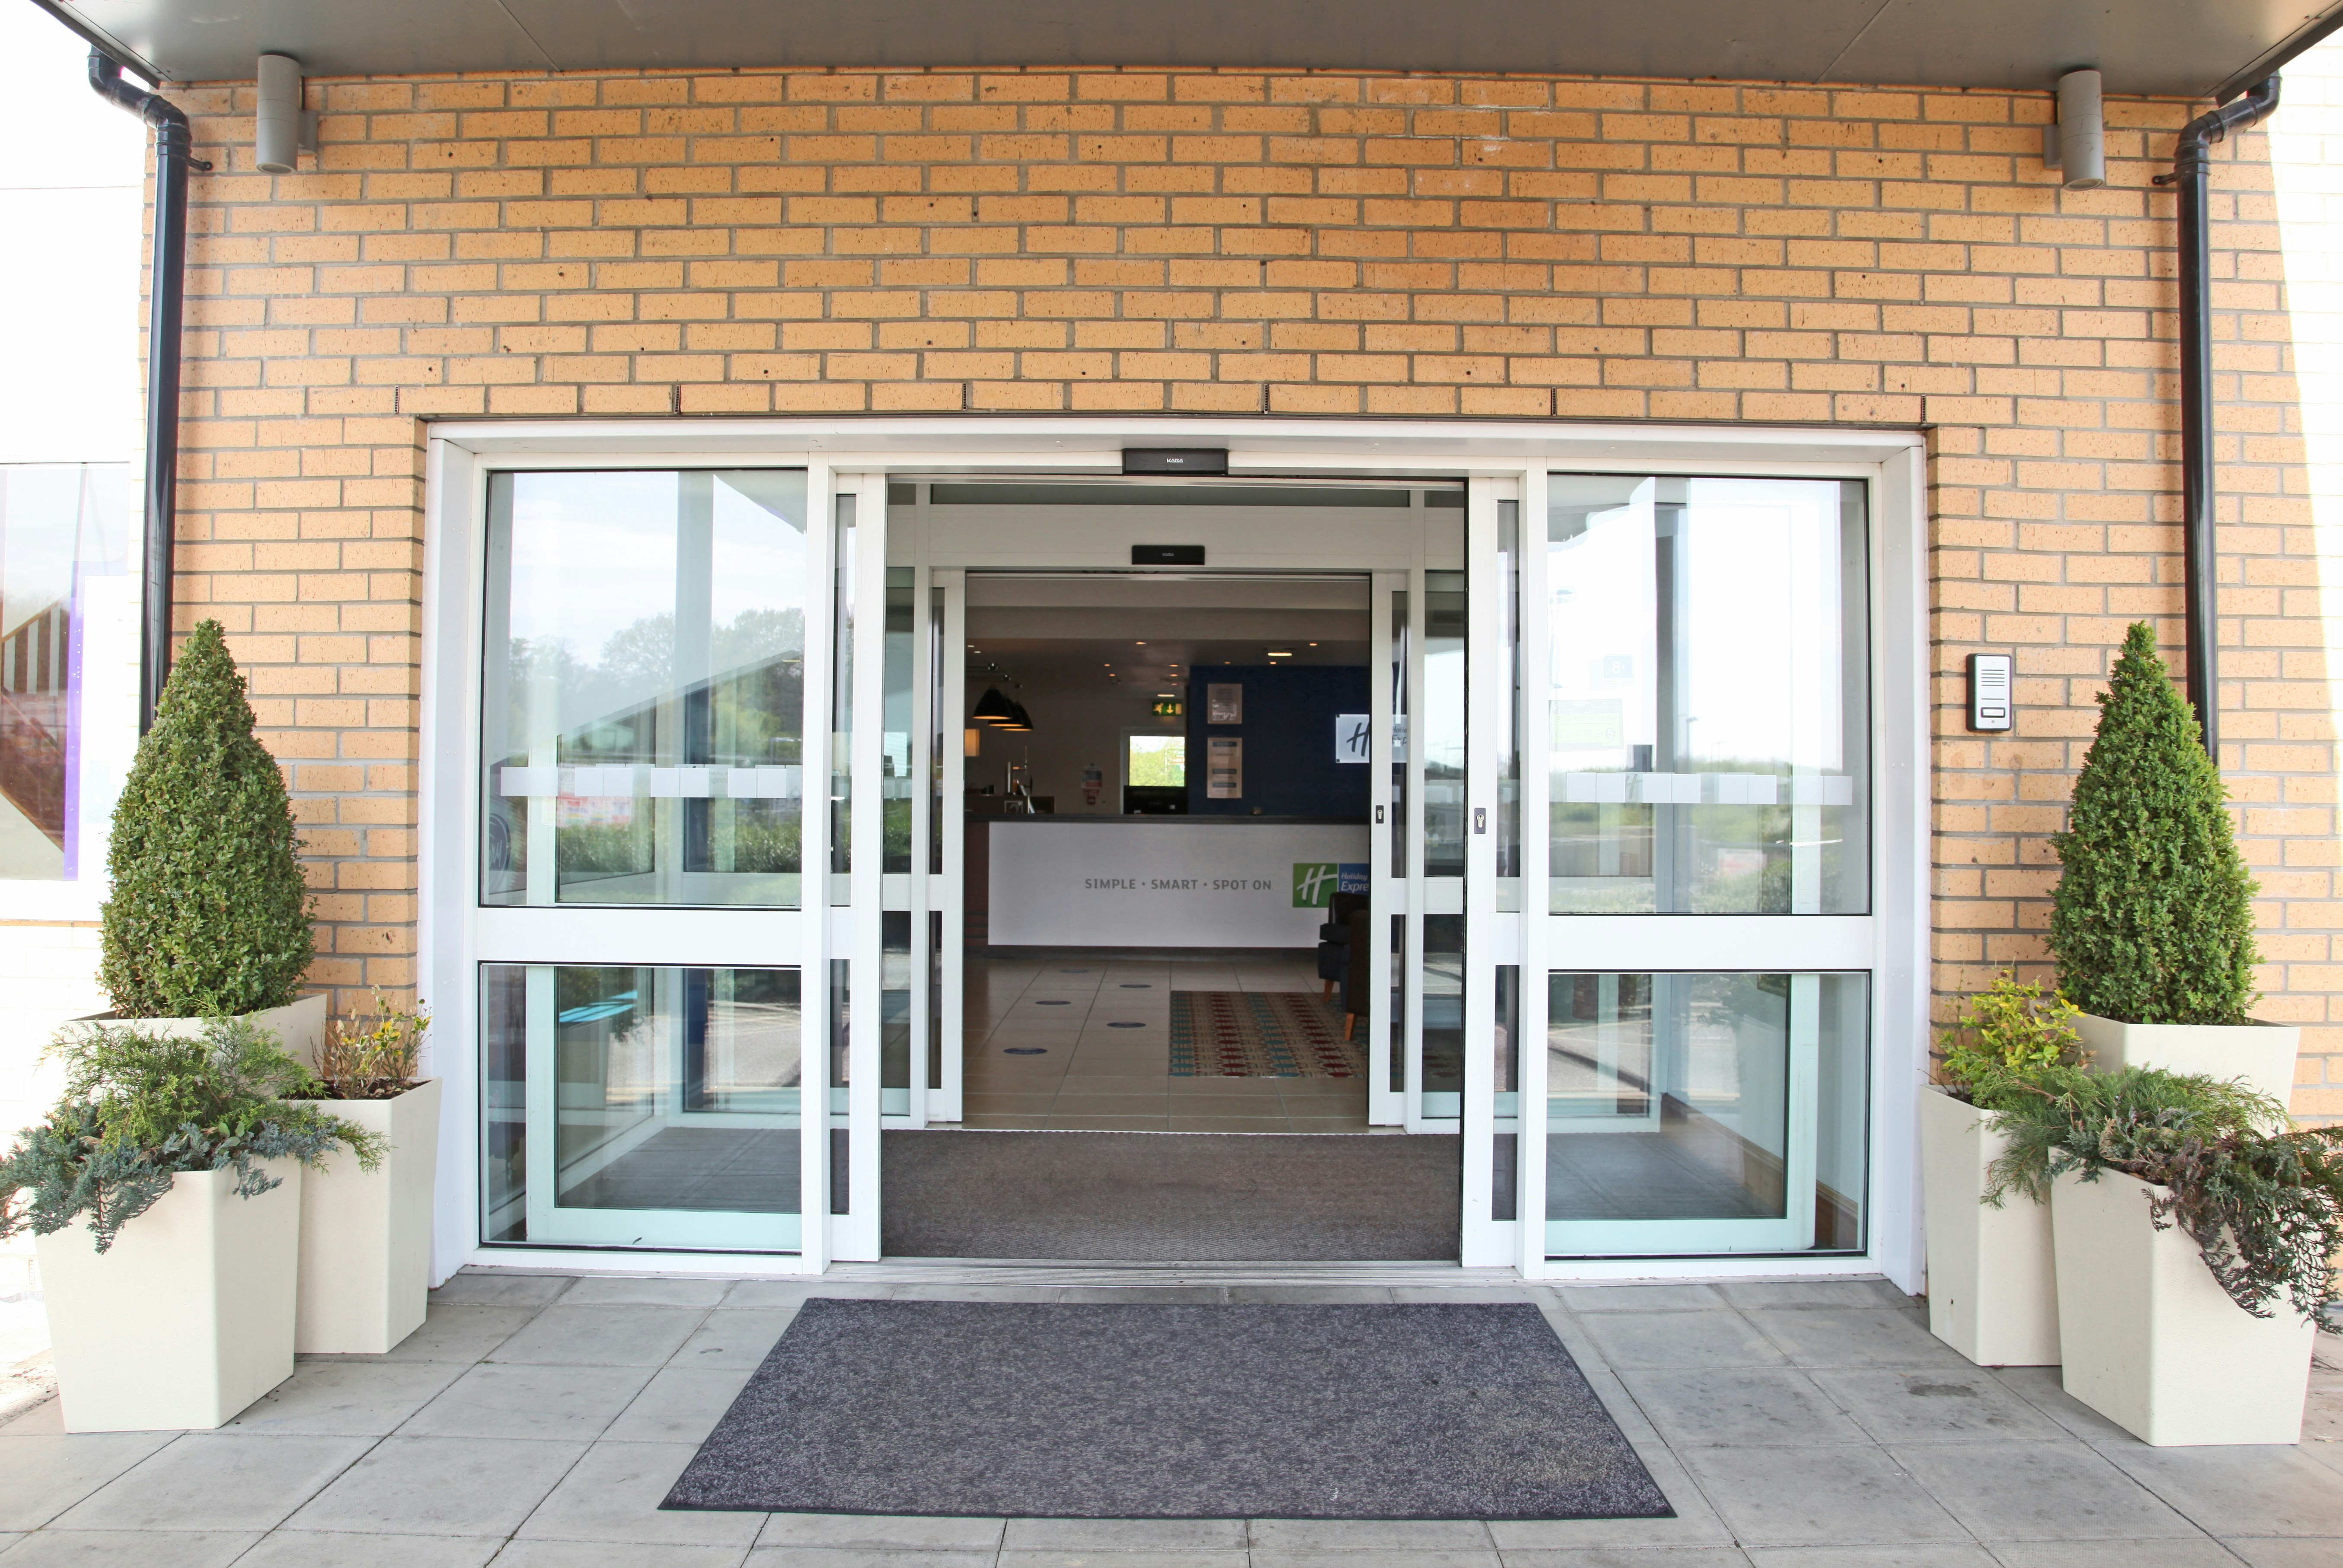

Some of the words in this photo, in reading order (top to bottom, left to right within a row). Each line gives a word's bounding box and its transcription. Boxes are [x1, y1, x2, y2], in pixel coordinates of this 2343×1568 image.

[1608, 729, 1614, 738] 5
[1341, 872, 1368, 881] Holiday
[1085, 879, 1136, 889] SIMPLE
[1151, 879, 1198, 890] SMART
[1213, 880, 1248, 890] SPOT
[1253, 880, 1271, 890] ON
[1341, 881, 1369, 893] Expre
